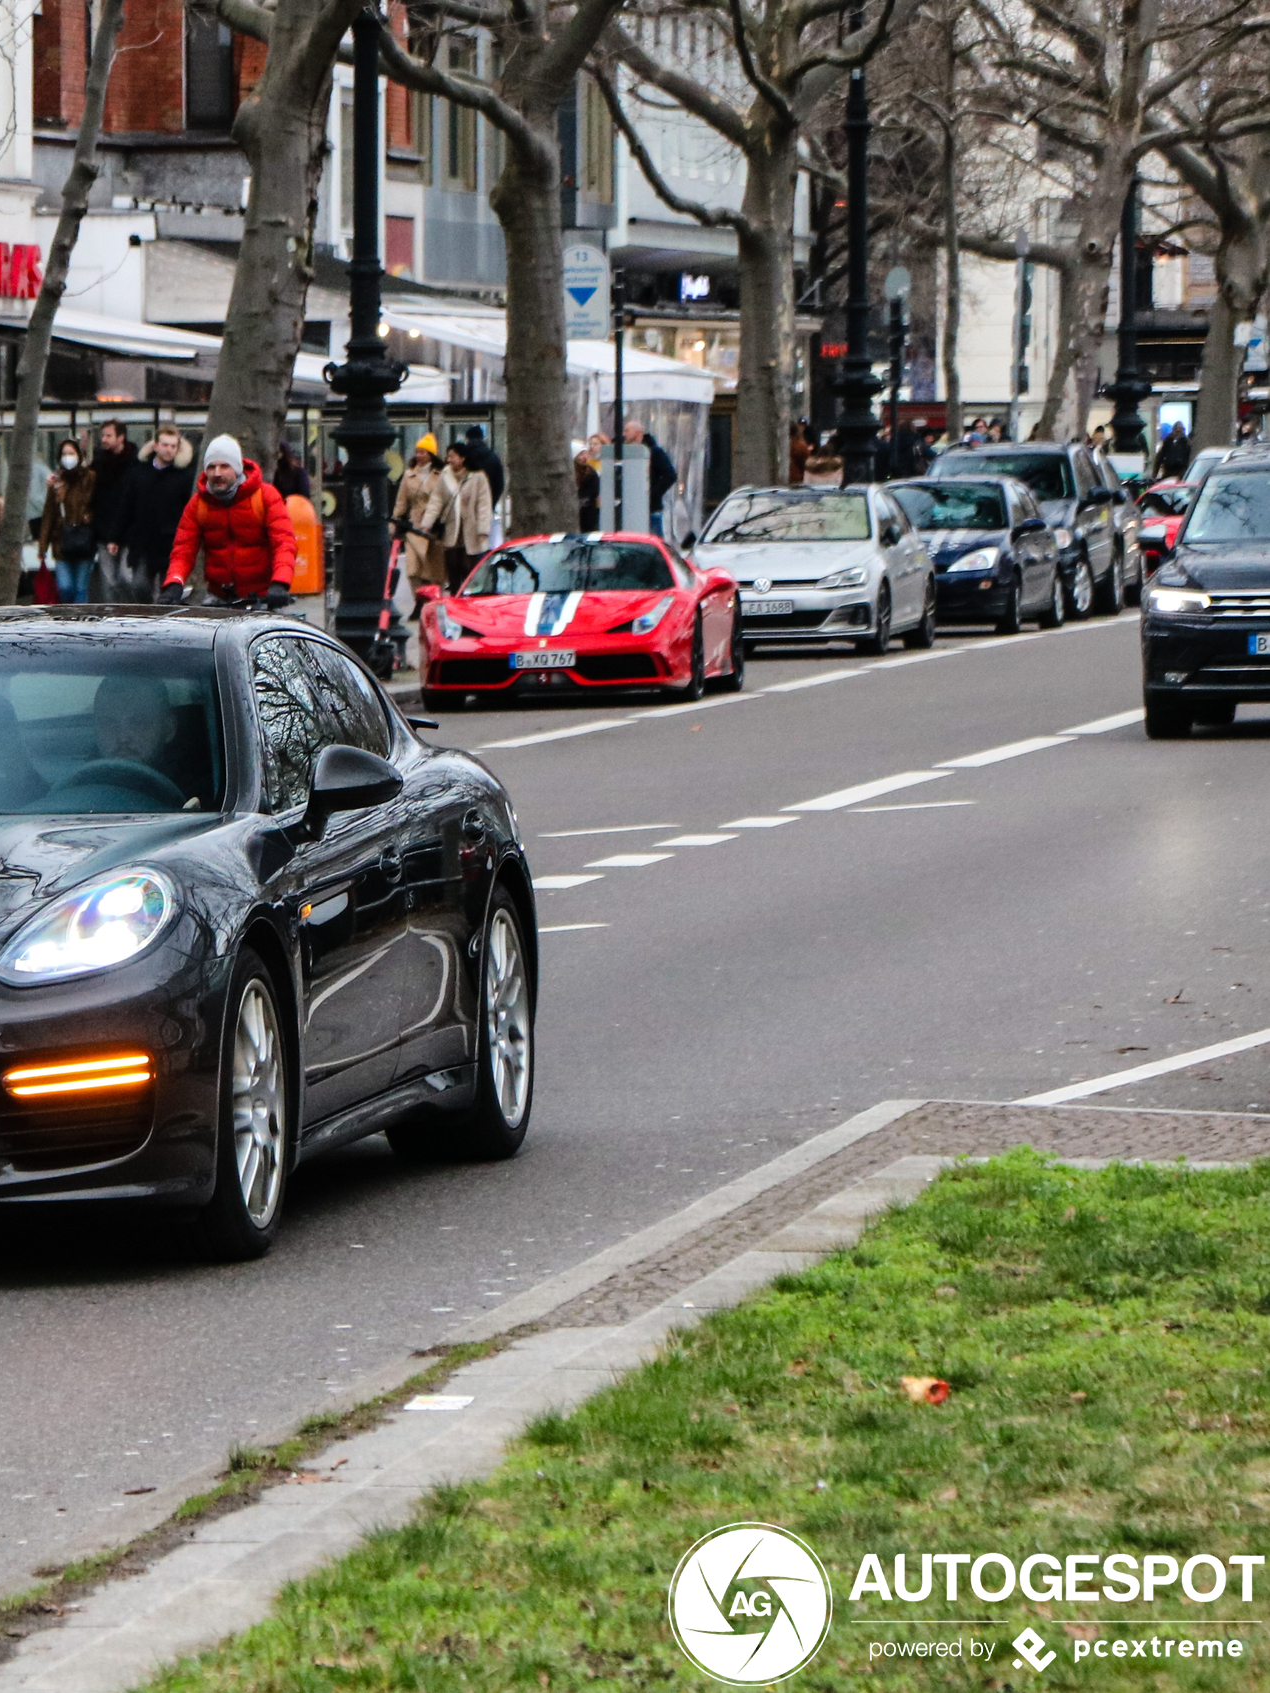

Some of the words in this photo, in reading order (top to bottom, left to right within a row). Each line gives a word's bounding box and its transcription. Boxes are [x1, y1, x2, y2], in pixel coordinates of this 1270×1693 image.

[1258, 637, 1267, 651] B
[516, 655, 524, 667] B
[551, 653, 573, 665] 767
